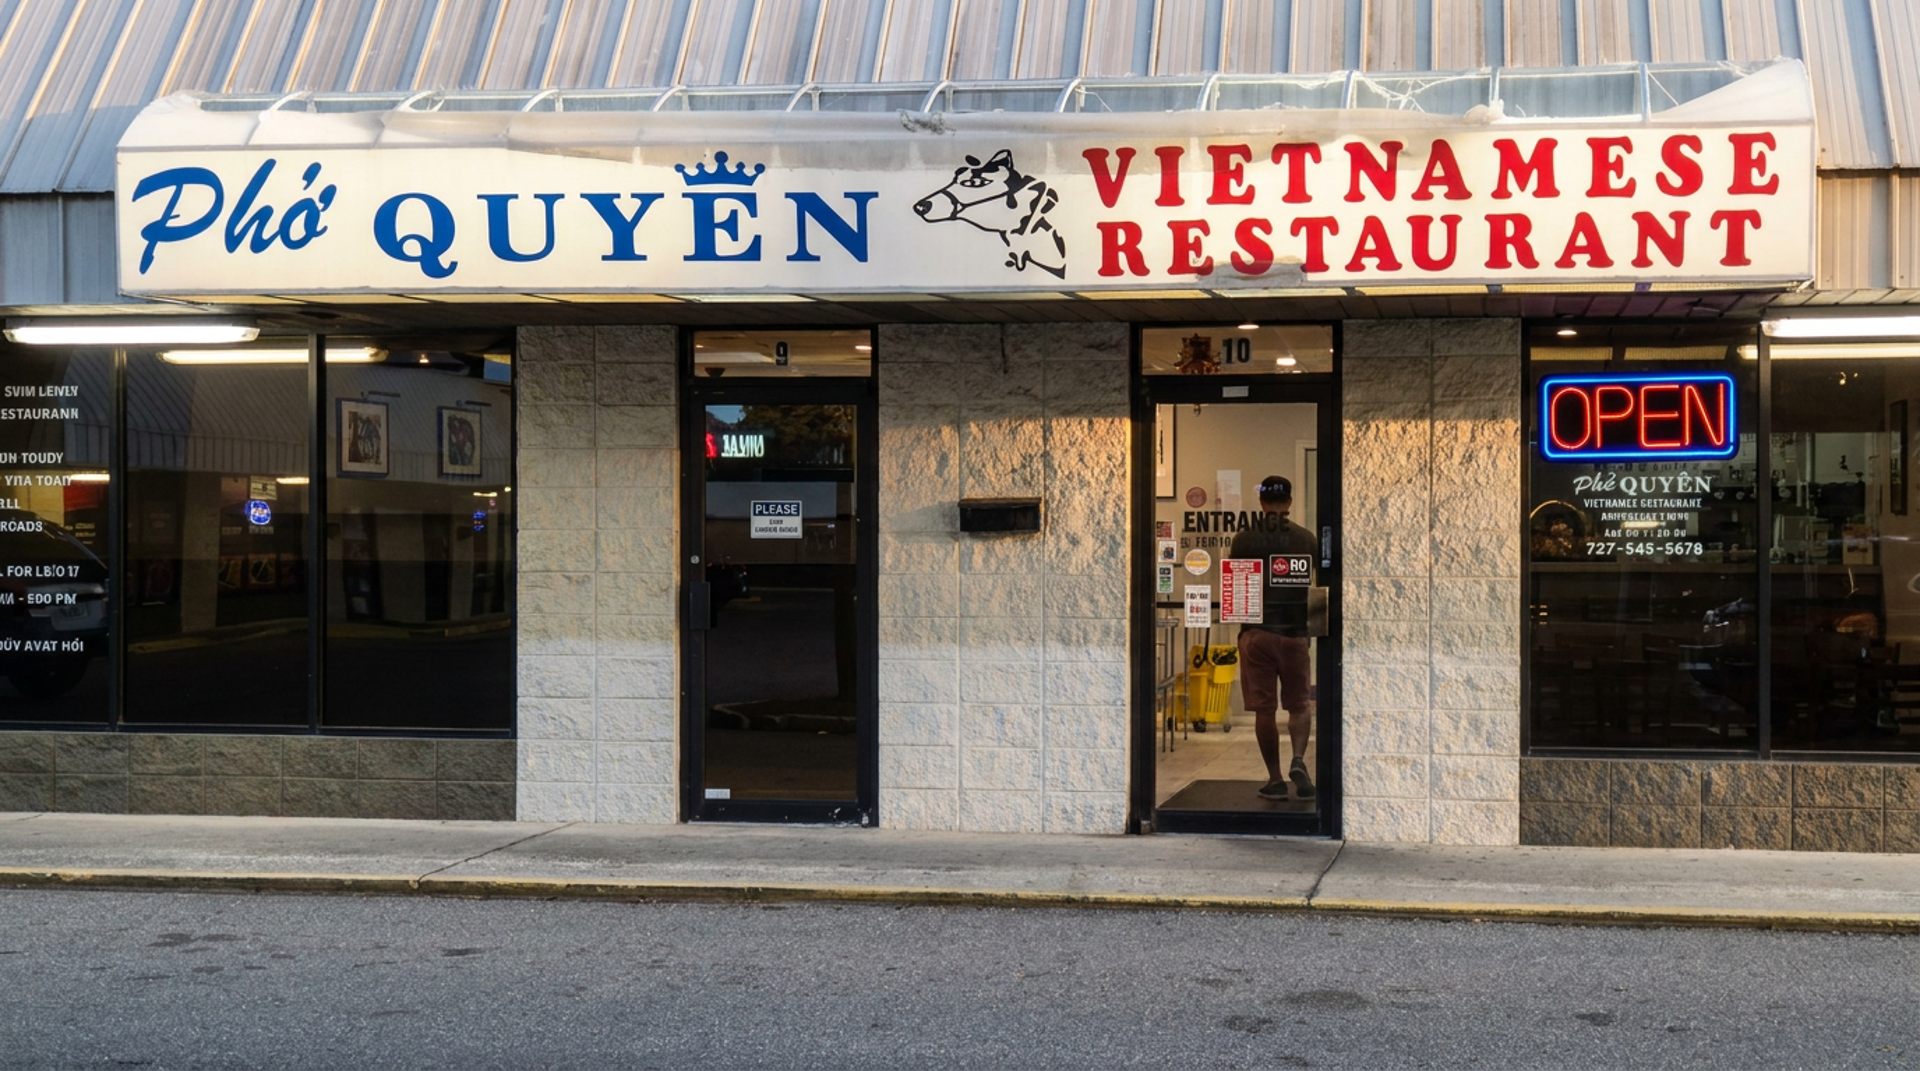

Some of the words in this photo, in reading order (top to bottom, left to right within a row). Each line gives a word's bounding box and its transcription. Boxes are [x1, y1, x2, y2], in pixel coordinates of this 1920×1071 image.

[1082, 131, 1780, 208] VIETNAMESE
[1096, 209, 1762, 276] RESTAURANT
[1222, 338, 1251, 364] 10
[1550, 383, 1725, 450] OPEN
[755, 504, 798, 515] PLEASE
[1184, 511, 1290, 532] ENTRANCE
[1586, 541, 1704, 556] 727-545-5678
[7, 565, 33, 577] FOR
